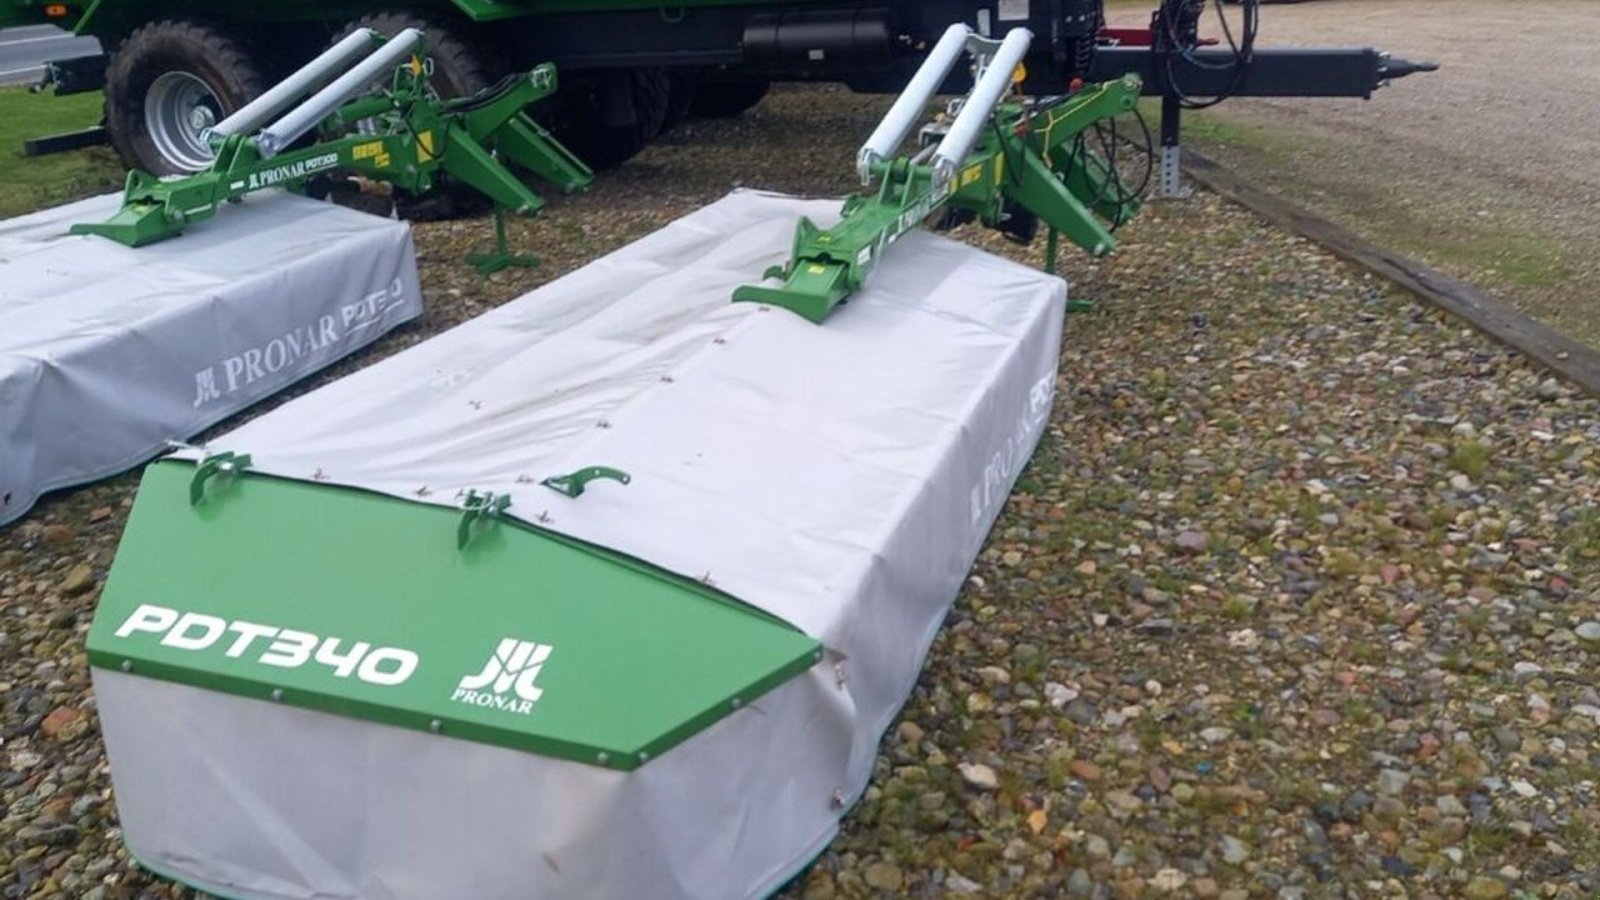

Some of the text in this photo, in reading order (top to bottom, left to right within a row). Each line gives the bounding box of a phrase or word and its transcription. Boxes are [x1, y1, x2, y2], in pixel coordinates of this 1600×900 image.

[260, 161, 305, 186] PRONAR
[225, 315, 338, 392] PRONAR
[114, 604, 419, 686] PDT340
[450, 688, 533, 715] PRONAR
